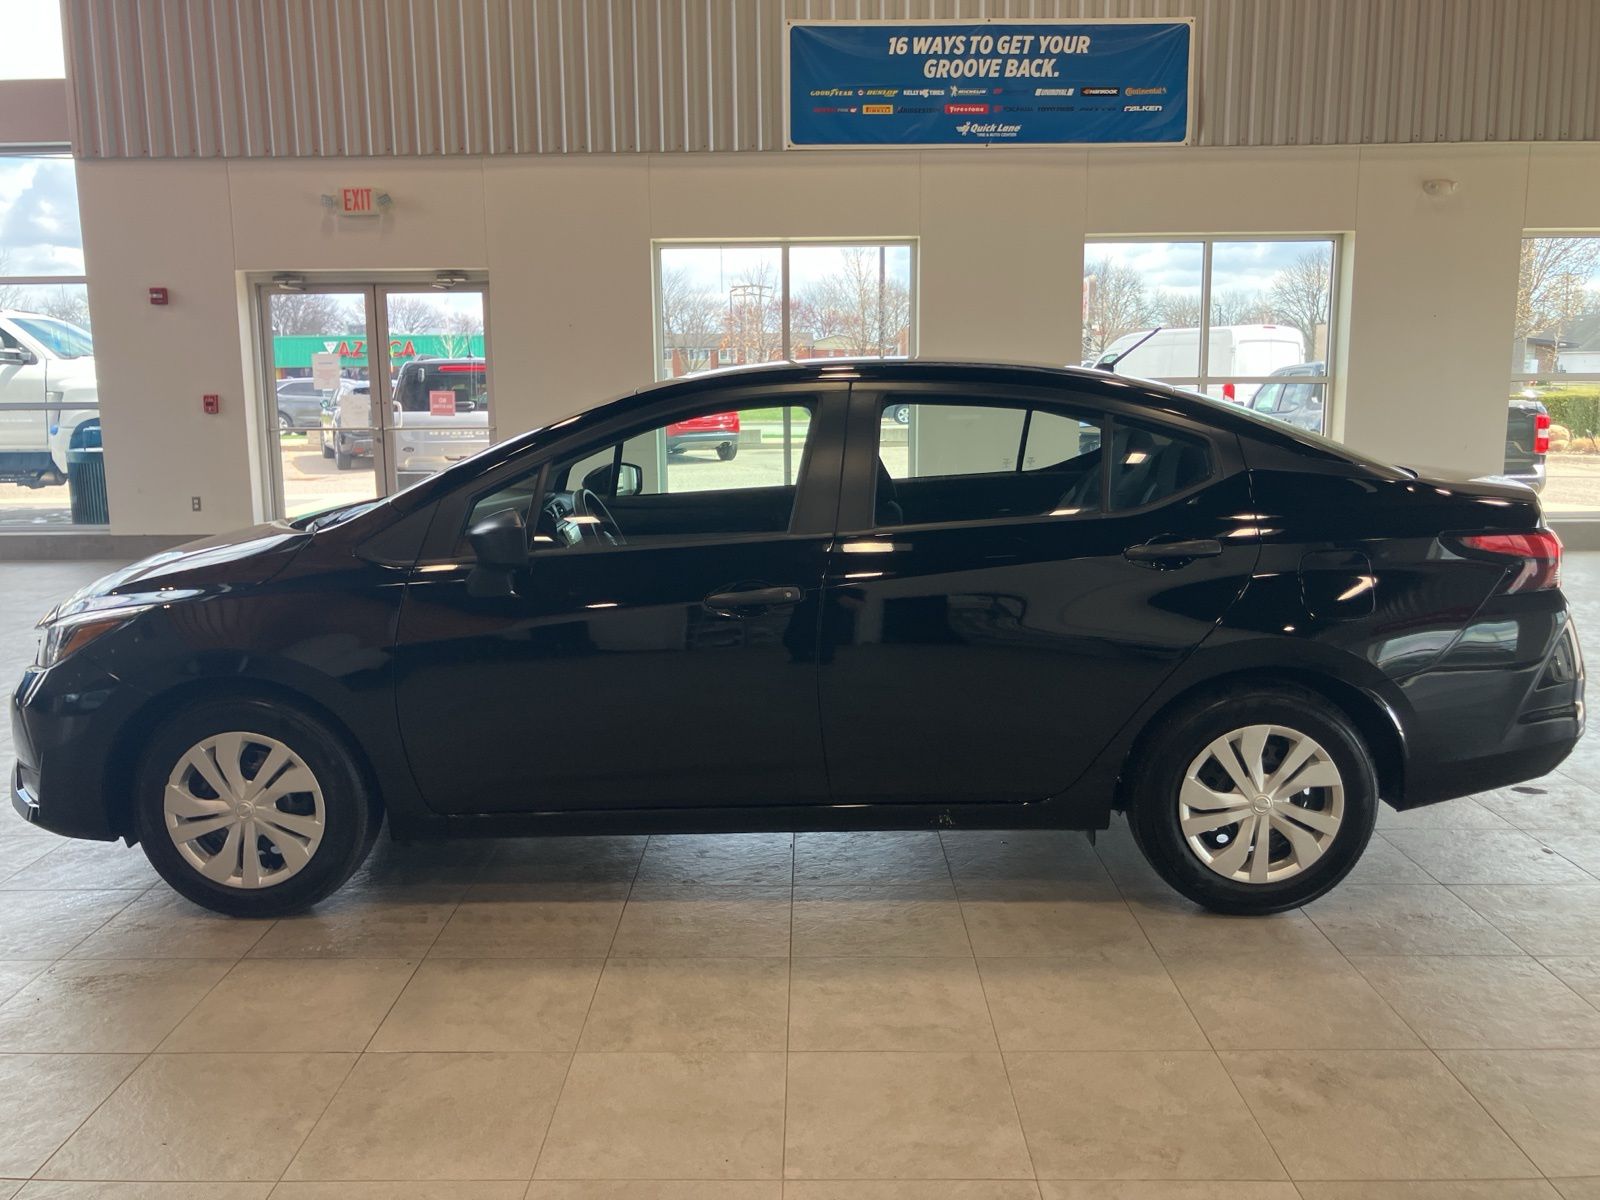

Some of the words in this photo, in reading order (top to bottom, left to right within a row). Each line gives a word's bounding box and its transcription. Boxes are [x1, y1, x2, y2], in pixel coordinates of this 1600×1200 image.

[888, 37, 908, 55] 16
[912, 36, 966, 55] WAYS
[969, 35, 993, 54] TO
[996, 35, 1034, 55] GET
[1038, 35, 1091, 54] YOUR
[923, 58, 1001, 78] GROOVE
[1004, 58, 1060, 78] BACK.
[810, 88, 853, 97] GOODYEAR
[970, 123, 997, 133] Quick
[997, 123, 1021, 132] Lane
[343, 188, 372, 211] EXIT
